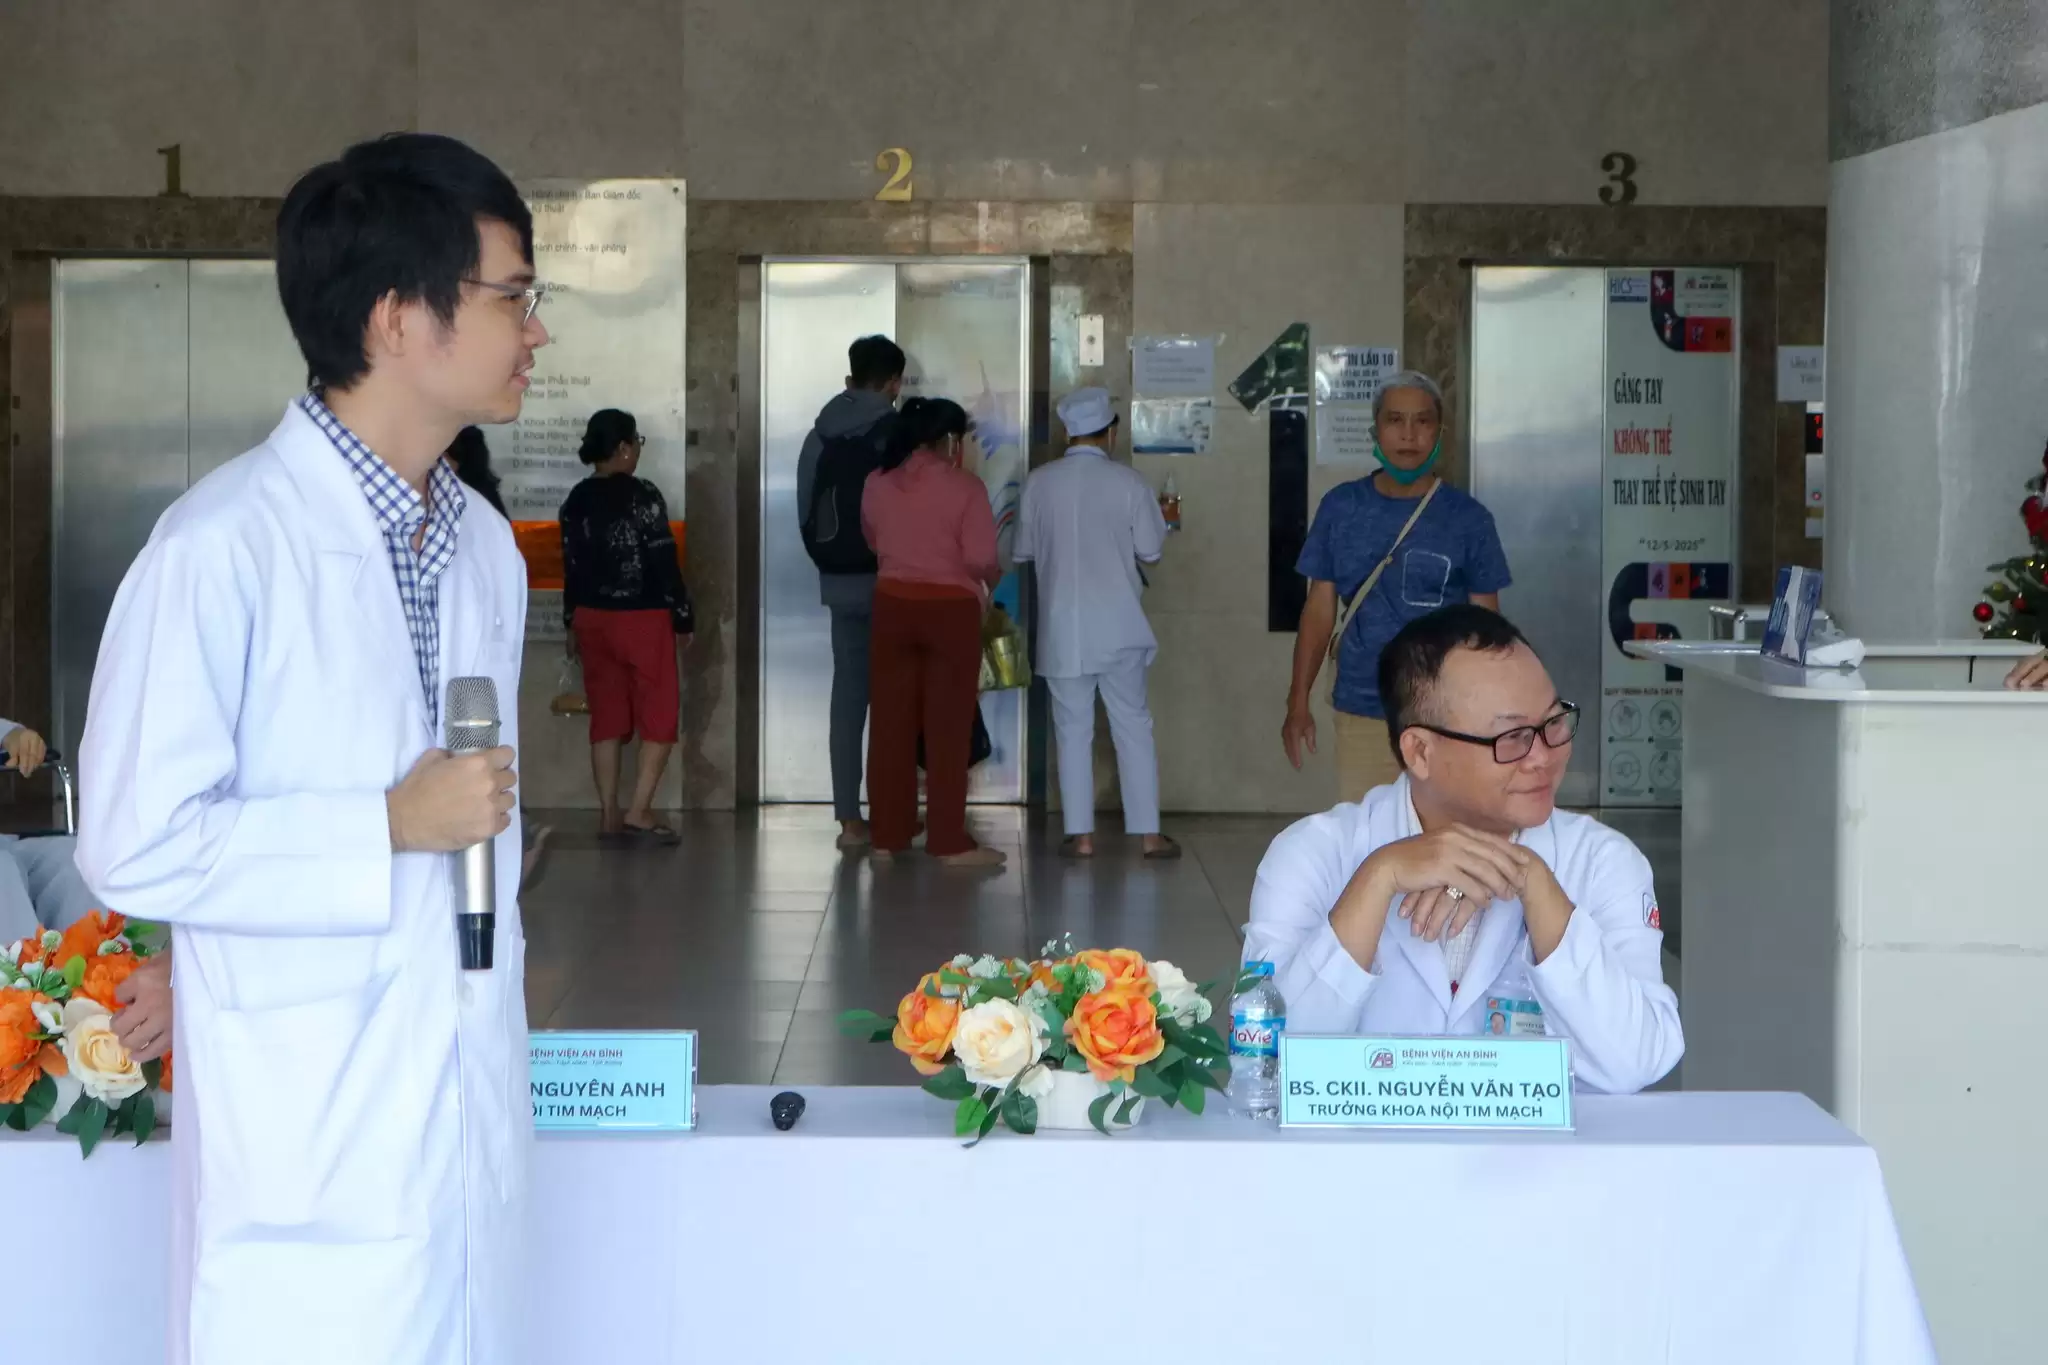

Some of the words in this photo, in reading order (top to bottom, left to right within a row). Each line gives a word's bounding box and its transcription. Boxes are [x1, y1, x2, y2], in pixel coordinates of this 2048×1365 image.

[157, 144, 191, 199] 1
[875, 147, 912, 201] 2
[1598, 151, 1637, 206] 3
[585, 190, 601, 200] Ban
[603, 189, 625, 200] Giám
[627, 188, 641, 200] đốc
[1382, 353, 1394, 366] 10
[1645, 377, 1664, 405] TAY
[1614, 420, 1650, 455] KHÔNG
[1613, 479, 1640, 505] THAY
[1664, 471, 1677, 513] VỆ
[1680, 479, 1705, 506] SINH
[1707, 479, 1727, 506] TAY
[557, 1048, 579, 1060] VIỆN
[581, 1049, 596, 1058] AN
[599, 1048, 623, 1058] BÌNH
[1402, 1048, 1429, 1060] BỆNH
[1432, 1048, 1454, 1060] VIỆN
[1456, 1050, 1471, 1059] AN
[1473, 1049, 1497, 1059] BÌNH
[530, 1078, 614, 1097] NGUYÊN
[620, 1082, 665, 1097] ANH
[1289, 1081, 1320, 1097] BS.
[1326, 1081, 1371, 1097] CKII.
[1378, 1075, 1464, 1098] NGUYỄN
[1471, 1079, 1512, 1098] VĂN
[1519, 1082, 1561, 1102] TẠO
[548, 1105, 575, 1117] TIM
[580, 1105, 626, 1120] MẠCH
[1308, 1100, 1377, 1117] TRƯỞNG
[1381, 1104, 1426, 1117] KHOA
[1431, 1102, 1459, 1120] NỘI
[1463, 1105, 1491, 1118] TIM
[1495, 1106, 1543, 1120] MẠCH
